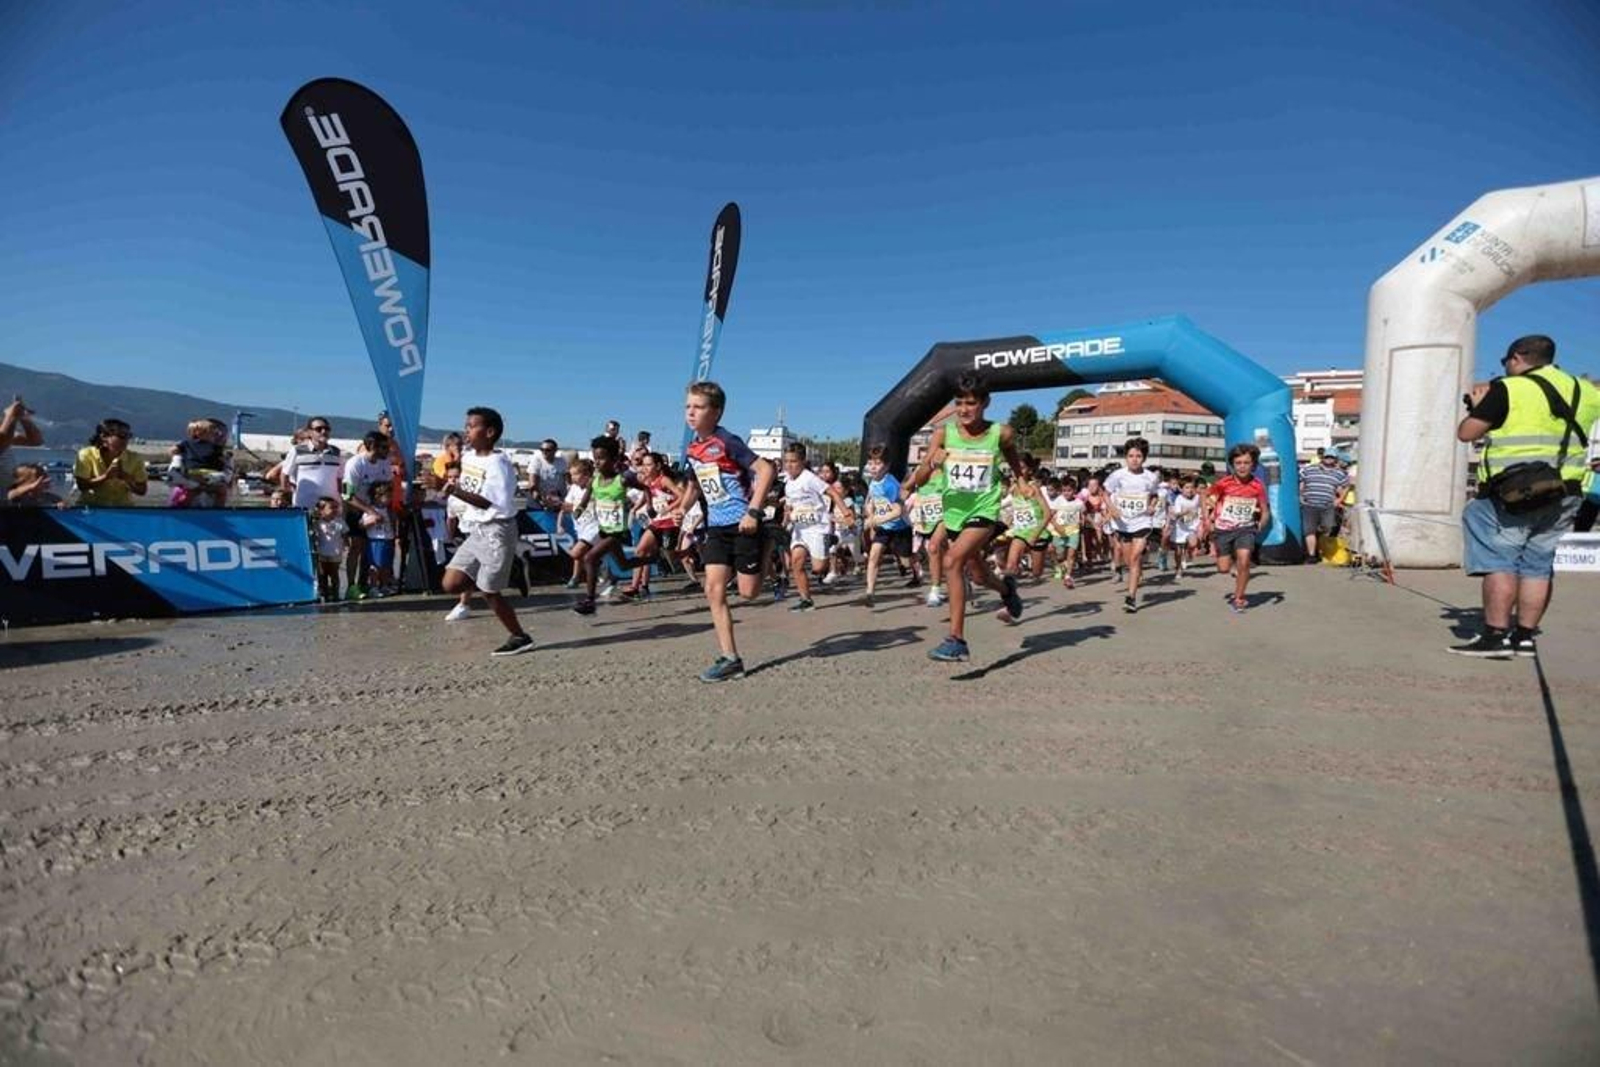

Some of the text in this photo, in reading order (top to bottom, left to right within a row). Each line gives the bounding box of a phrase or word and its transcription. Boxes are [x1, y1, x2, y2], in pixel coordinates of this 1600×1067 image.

[974, 336, 1124, 370] POWERADE
[950, 464, 988, 481] 447
[701, 477, 718, 494] 50
[1119, 500, 1144, 510] 449
